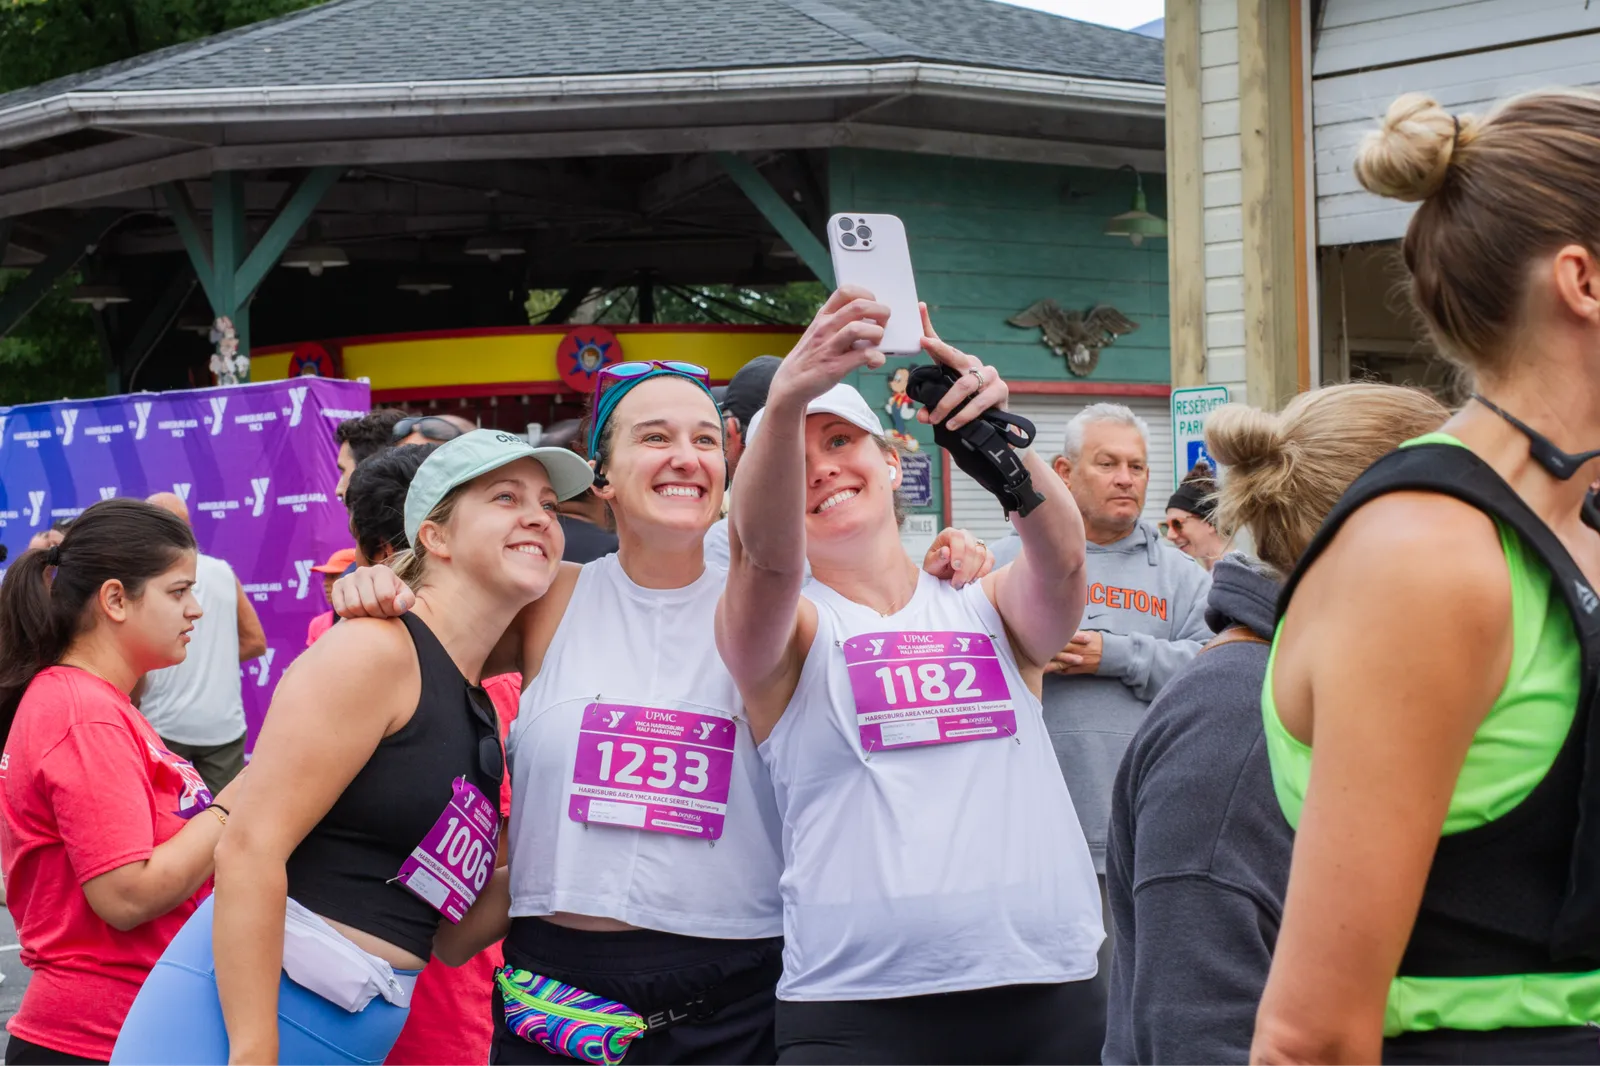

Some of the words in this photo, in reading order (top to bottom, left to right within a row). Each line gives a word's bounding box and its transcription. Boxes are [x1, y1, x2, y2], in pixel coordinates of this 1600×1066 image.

[903, 634, 934, 643] UPMC
[875, 661, 982, 705] 1182
[645, 711, 678, 723] UPMC
[864, 712, 904, 722] HARRISBURG
[650, 728, 682, 736] MARATHON
[597, 741, 708, 793] 1233
[578, 786, 617, 797] HARRISBURG
[634, 793, 652, 801] YMCA
[653, 795, 668, 804] RACE
[669, 797, 689, 806] SERIES
[418, 852, 443, 875] HARRISBURG
[435, 817, 492, 891] 1006
